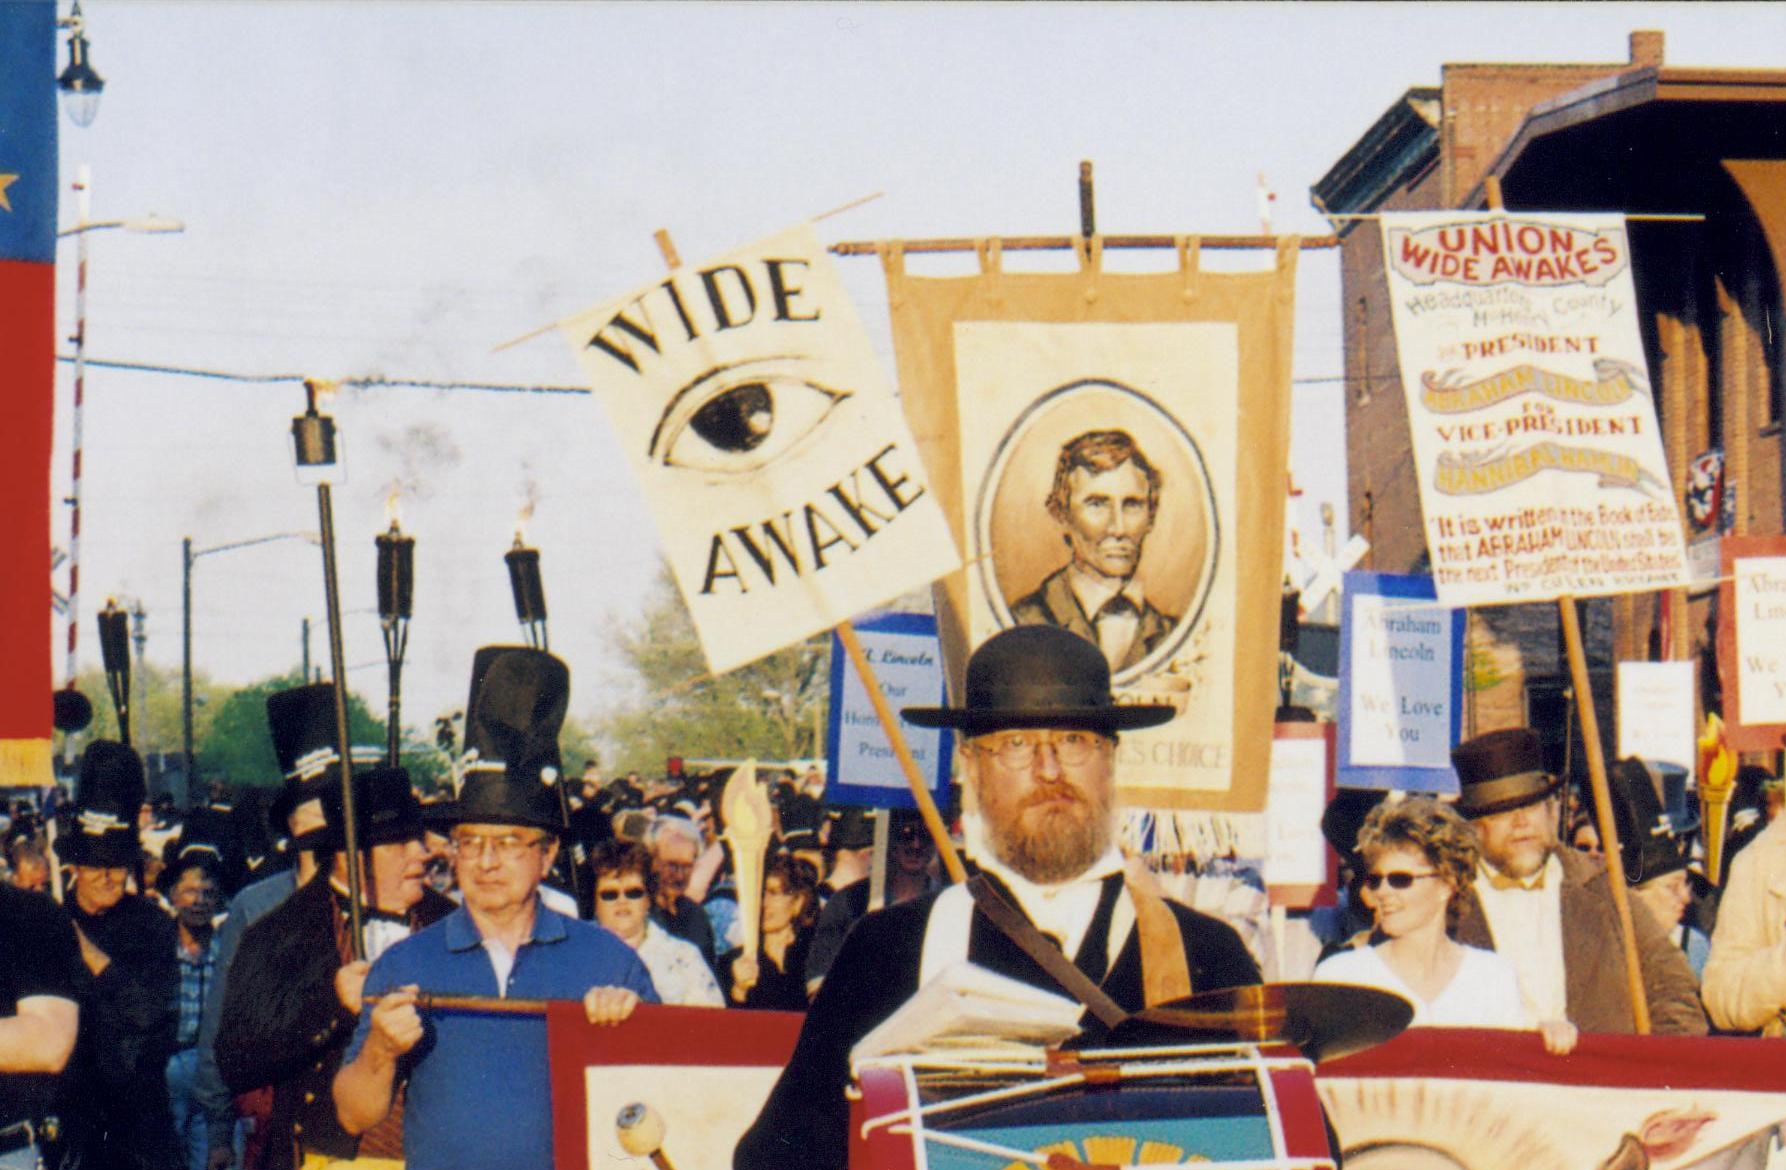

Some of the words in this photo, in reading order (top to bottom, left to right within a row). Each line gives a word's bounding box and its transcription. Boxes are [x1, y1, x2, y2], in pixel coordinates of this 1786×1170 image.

[1438, 222, 1575, 256] UNION
[1401, 234, 1480, 281] WIDE
[1490, 237, 1618, 281] AWAKES
[586, 258, 822, 376] WIDE
[1462, 332, 1599, 360] PRESIDENT
[701, 444, 926, 597] AWAKE
[1459, 515, 1481, 536] is
[1484, 506, 1552, 533] written
[1598, 503, 1633, 526] Book
[1438, 539, 1472, 563] that
[1477, 526, 1563, 559] ABRAHAM
[1438, 565, 1463, 585] the
[1467, 563, 1498, 583] next
[881, 648, 934, 667] Lincoln
[1368, 637, 1435, 662] Lncoln
[1746, 654, 1777, 673] We
[844, 710, 881, 726] Hom
[1400, 695, 1443, 717] Love
[858, 740, 926, 760] Presint
[1146, 740, 1225, 769] CHOICE
